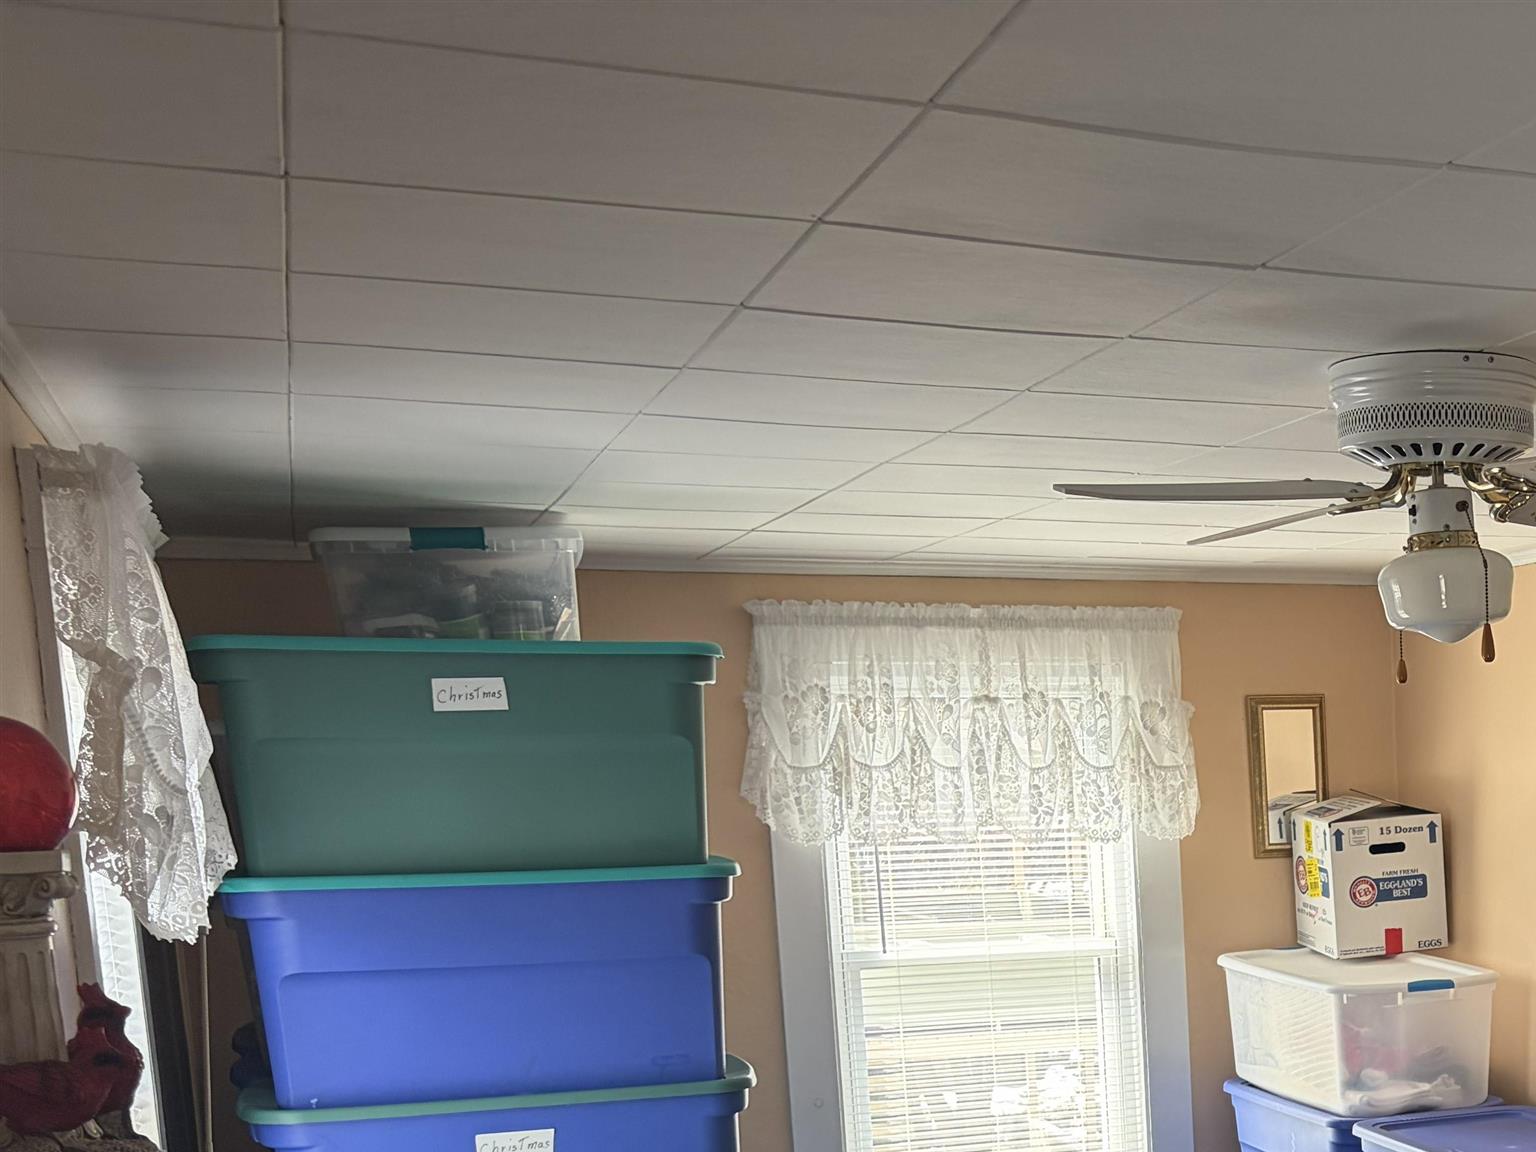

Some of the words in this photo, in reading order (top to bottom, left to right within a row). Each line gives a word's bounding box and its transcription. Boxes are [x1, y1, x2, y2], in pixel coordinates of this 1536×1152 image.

[1379, 826, 1392, 835] 15
[1394, 825, 1424, 834] Dozen
[1392, 887, 1412, 898] BEST
[1417, 938, 1442, 949] EGGS
